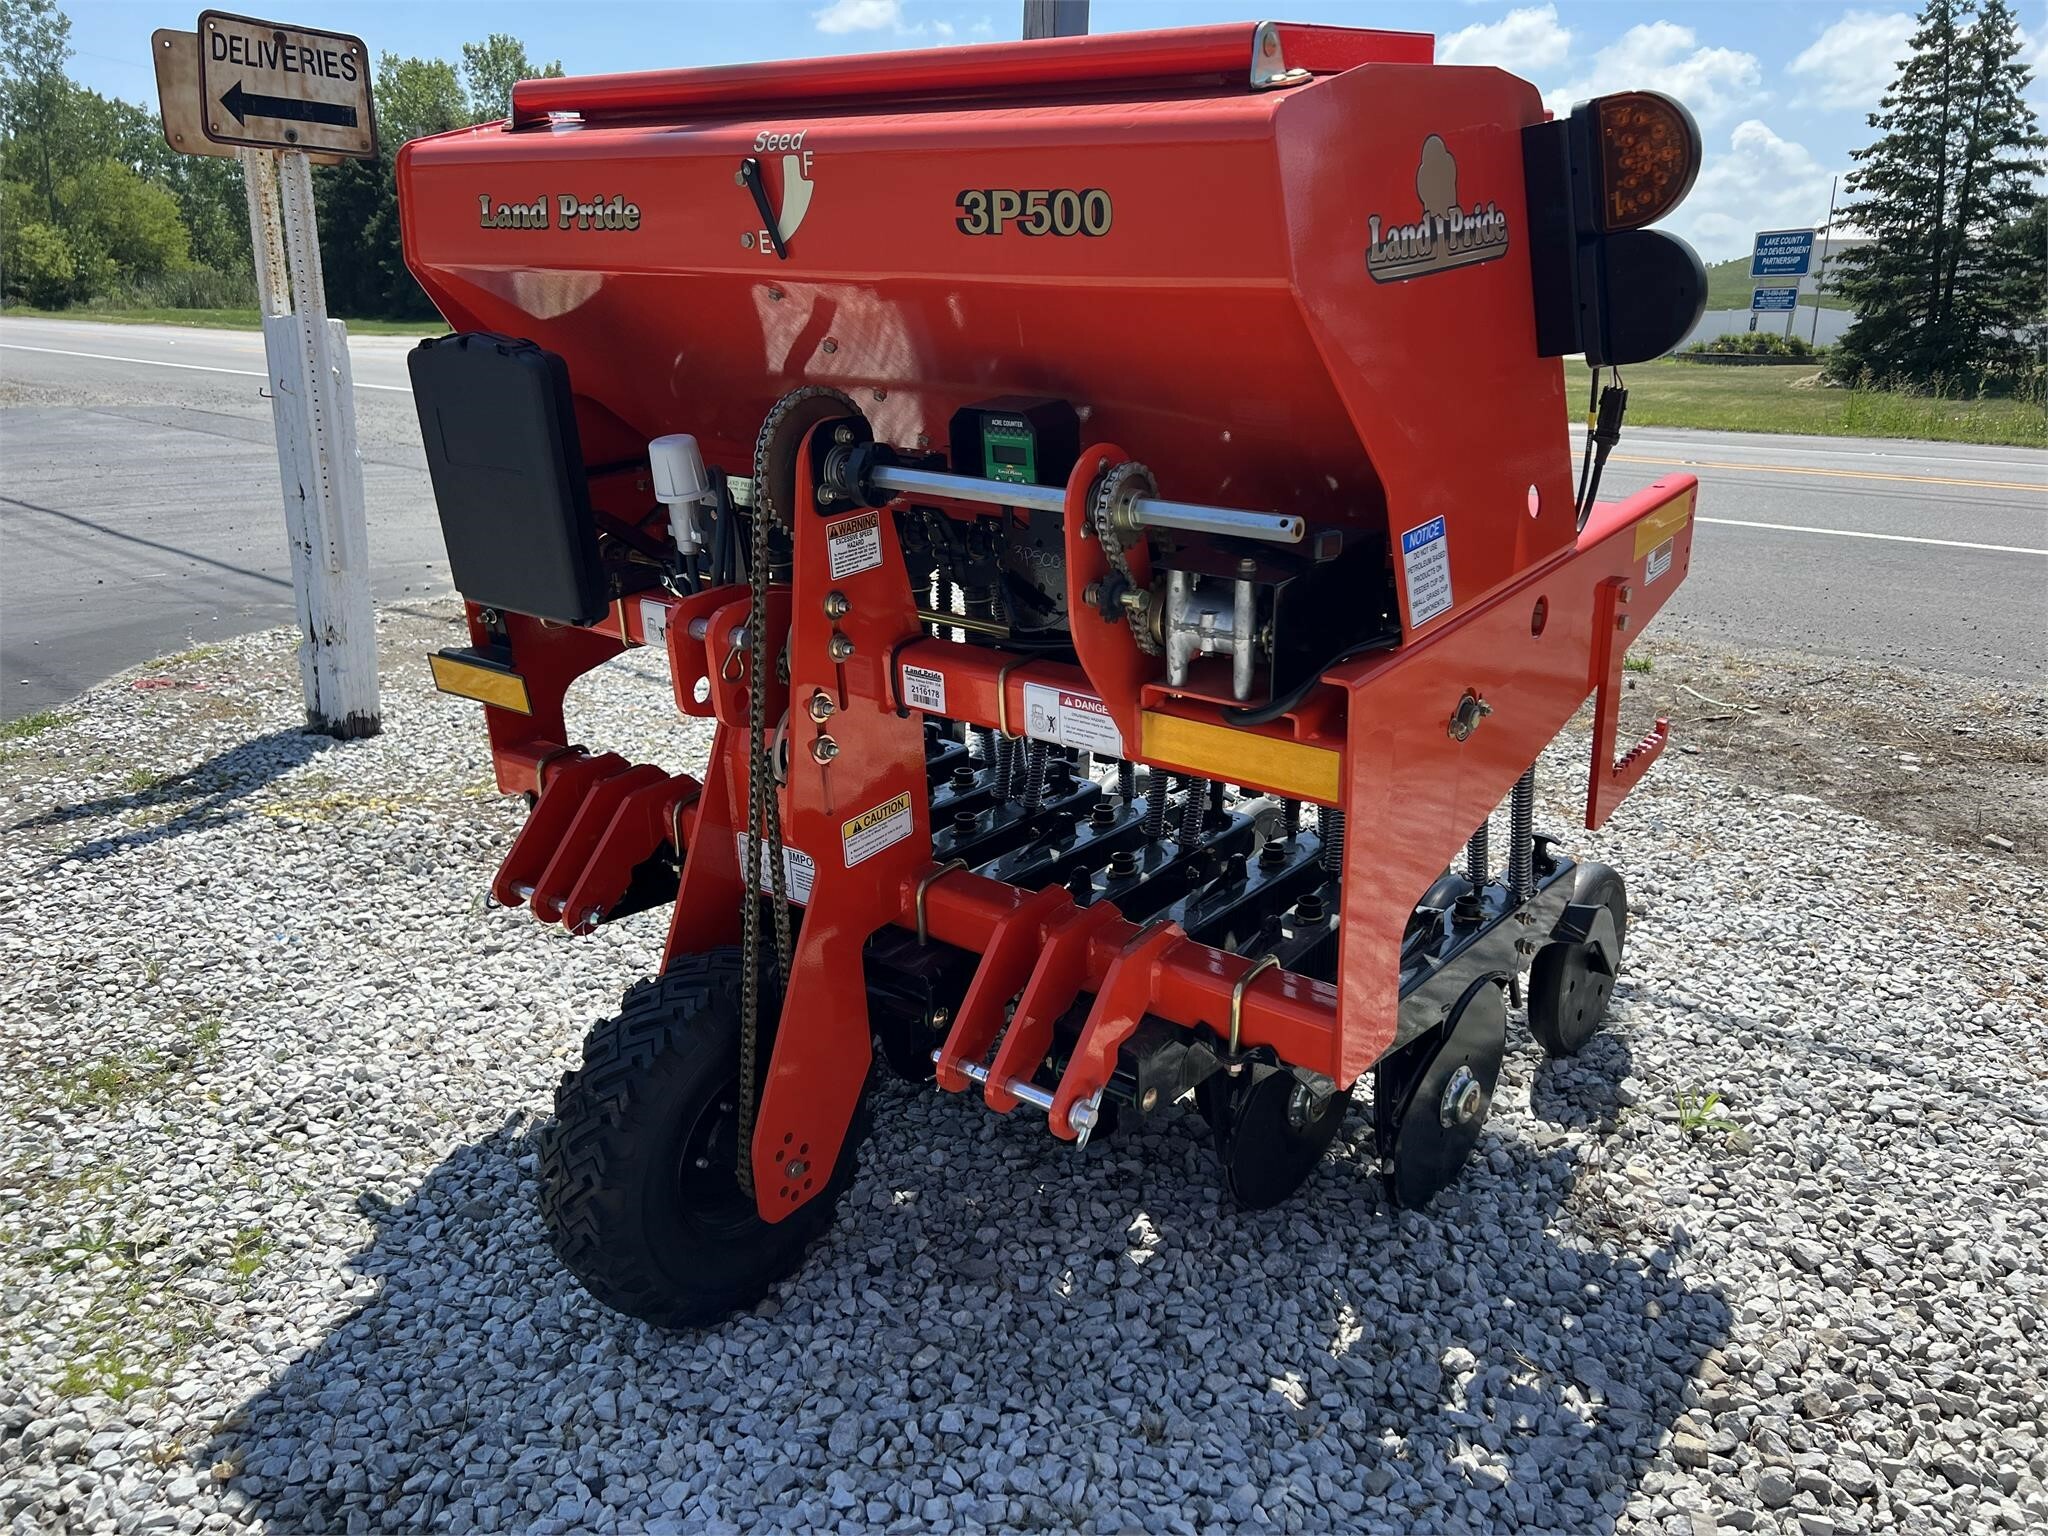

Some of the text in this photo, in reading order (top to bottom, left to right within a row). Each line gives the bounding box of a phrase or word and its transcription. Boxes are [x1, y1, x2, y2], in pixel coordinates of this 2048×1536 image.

[211, 31, 358, 82] DELIVERIES
[753, 128, 808, 153] Seed
[803, 150, 814, 177] F
[478, 193, 641, 231] Land Pride
[955, 188, 1113, 237] 3P500
[758, 229, 772, 255] E
[1368, 200, 1507, 264] Land Pride
[1764, 235, 1805, 246] LAKE COUNTY
[1761, 256, 1801, 266] PARTNERSHIP
[1768, 245, 1811, 256] DEVELOPMENT
[1003, 420, 1024, 428] COUNTER
[838, 514, 877, 535] WARNING
[1408, 520, 1441, 549] NOTICE
[835, 528, 873, 546] EXCESSIVE SPEED
[1407, 557, 1432, 574] PETROLEUM
[1413, 566, 1435, 584] PRODUCTS
[911, 685, 940, 699] 2116178
[1074, 698, 1109, 714] DANGE
[863, 797, 904, 827] CAUTION
